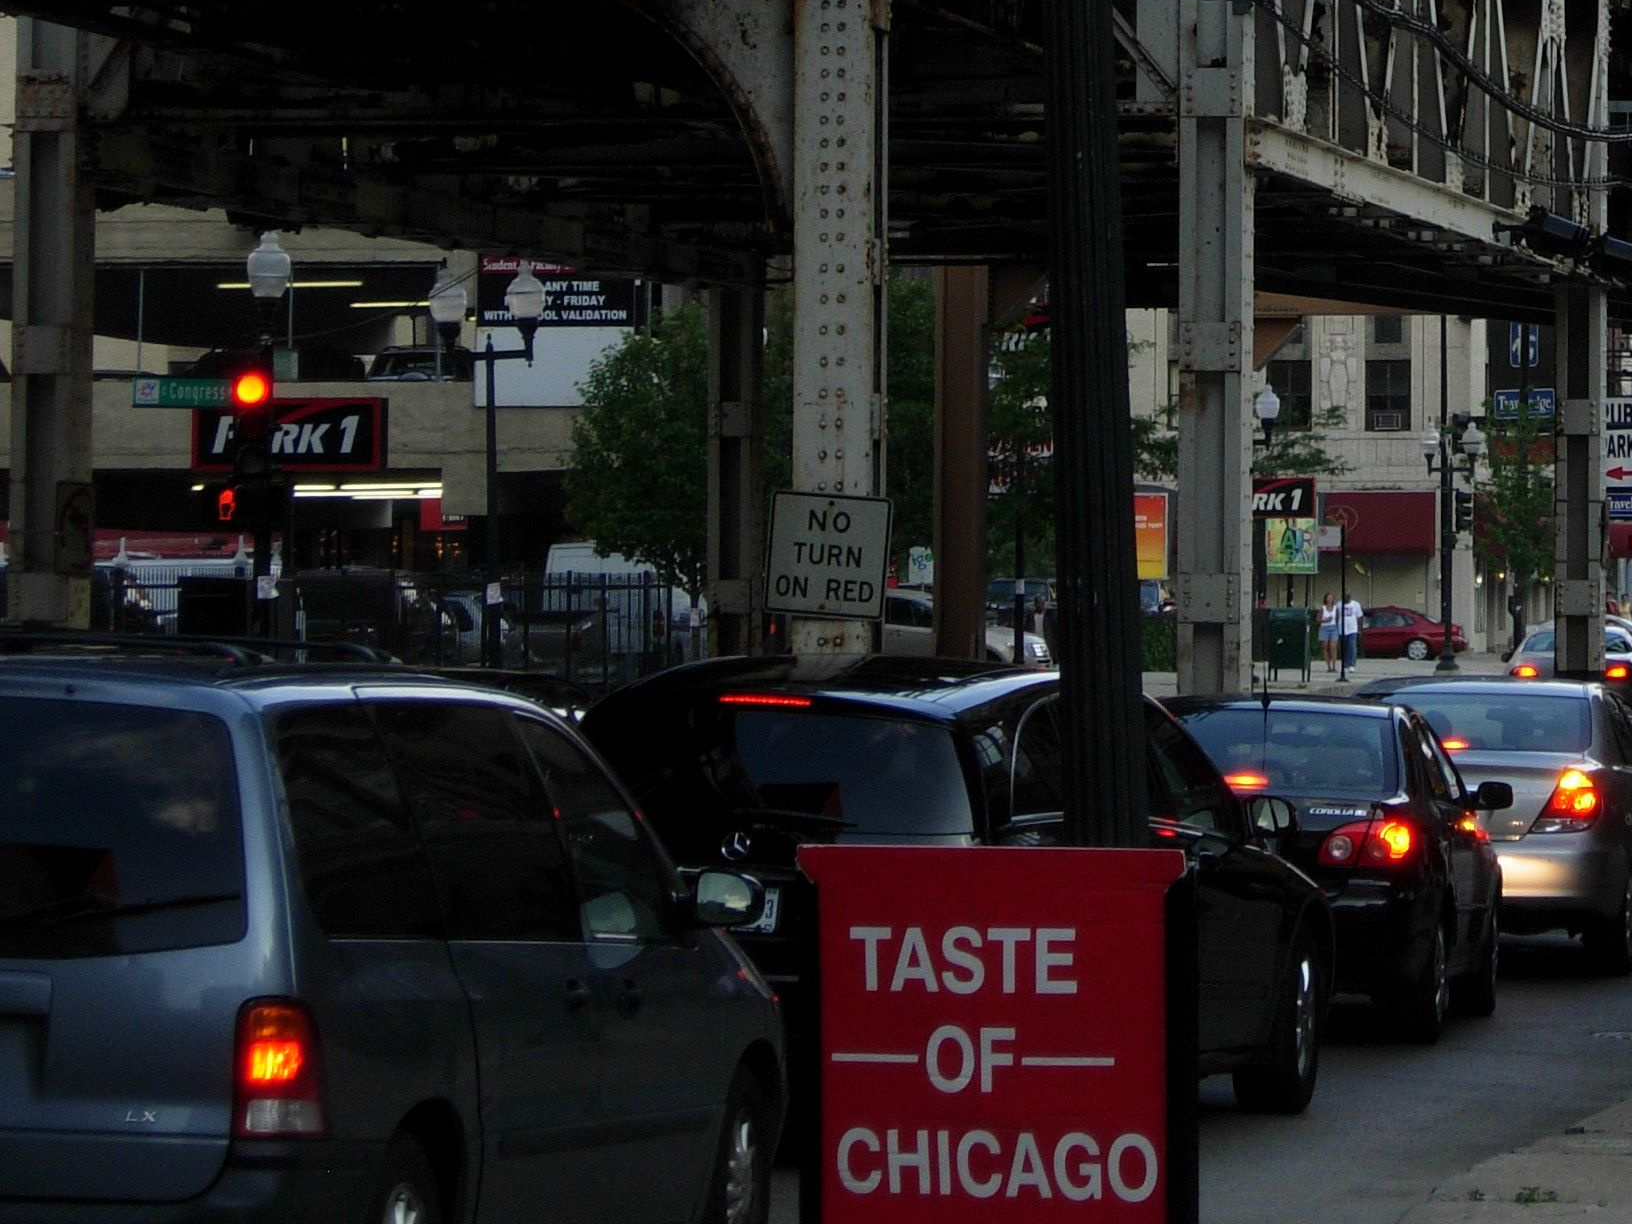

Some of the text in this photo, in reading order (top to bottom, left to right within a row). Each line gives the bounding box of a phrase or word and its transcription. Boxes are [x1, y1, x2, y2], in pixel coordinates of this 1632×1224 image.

[543, 280, 600, 291] ANY TIME
[563, 295, 606, 306] FRIDAY
[484, 310, 512, 321] WITH
[562, 310, 627, 320] VALIDATION
[169, 381, 227, 405] Congress
[339, 415, 361, 454] 1
[1252, 488, 1303, 511] RK 1
[808, 509, 851, 533] NO
[793, 542, 862, 568] TURN
[776, 574, 874, 603] ON RED
[849, 925, 1078, 995] TASTE
[925, 1024, 1017, 1094] OF
[125, 1110, 157, 1122] LX
[836, 1126, 1159, 1203] CHICAGO
